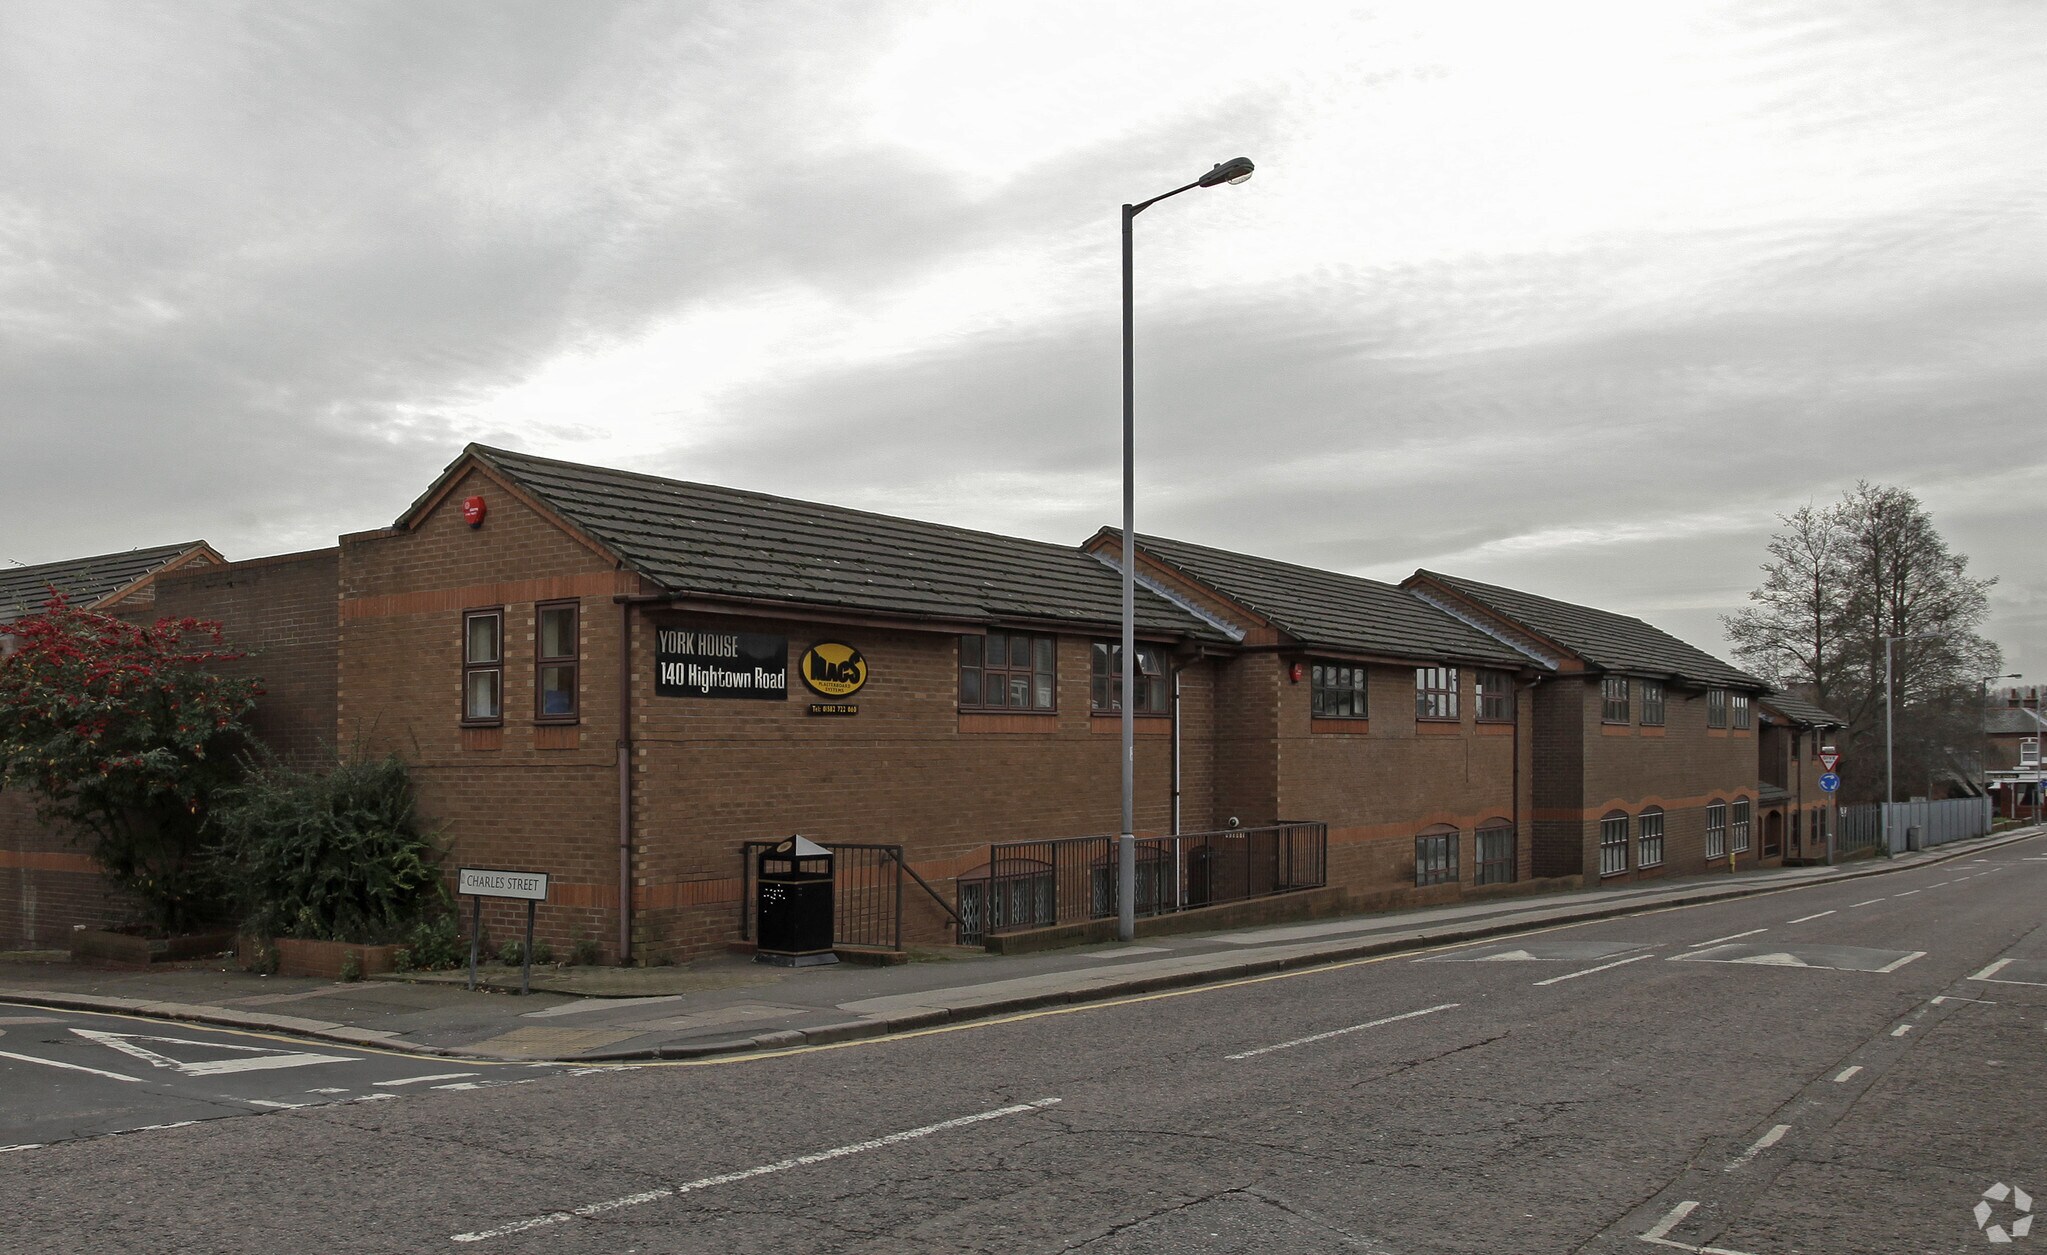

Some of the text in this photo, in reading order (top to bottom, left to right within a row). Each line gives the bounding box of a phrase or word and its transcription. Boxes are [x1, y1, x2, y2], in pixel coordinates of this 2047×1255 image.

[659, 630, 738, 658] YORK HOUSE
[661, 661, 785, 693] 140 Hightown Road
[466, 874, 539, 891] CHARLES STREET
